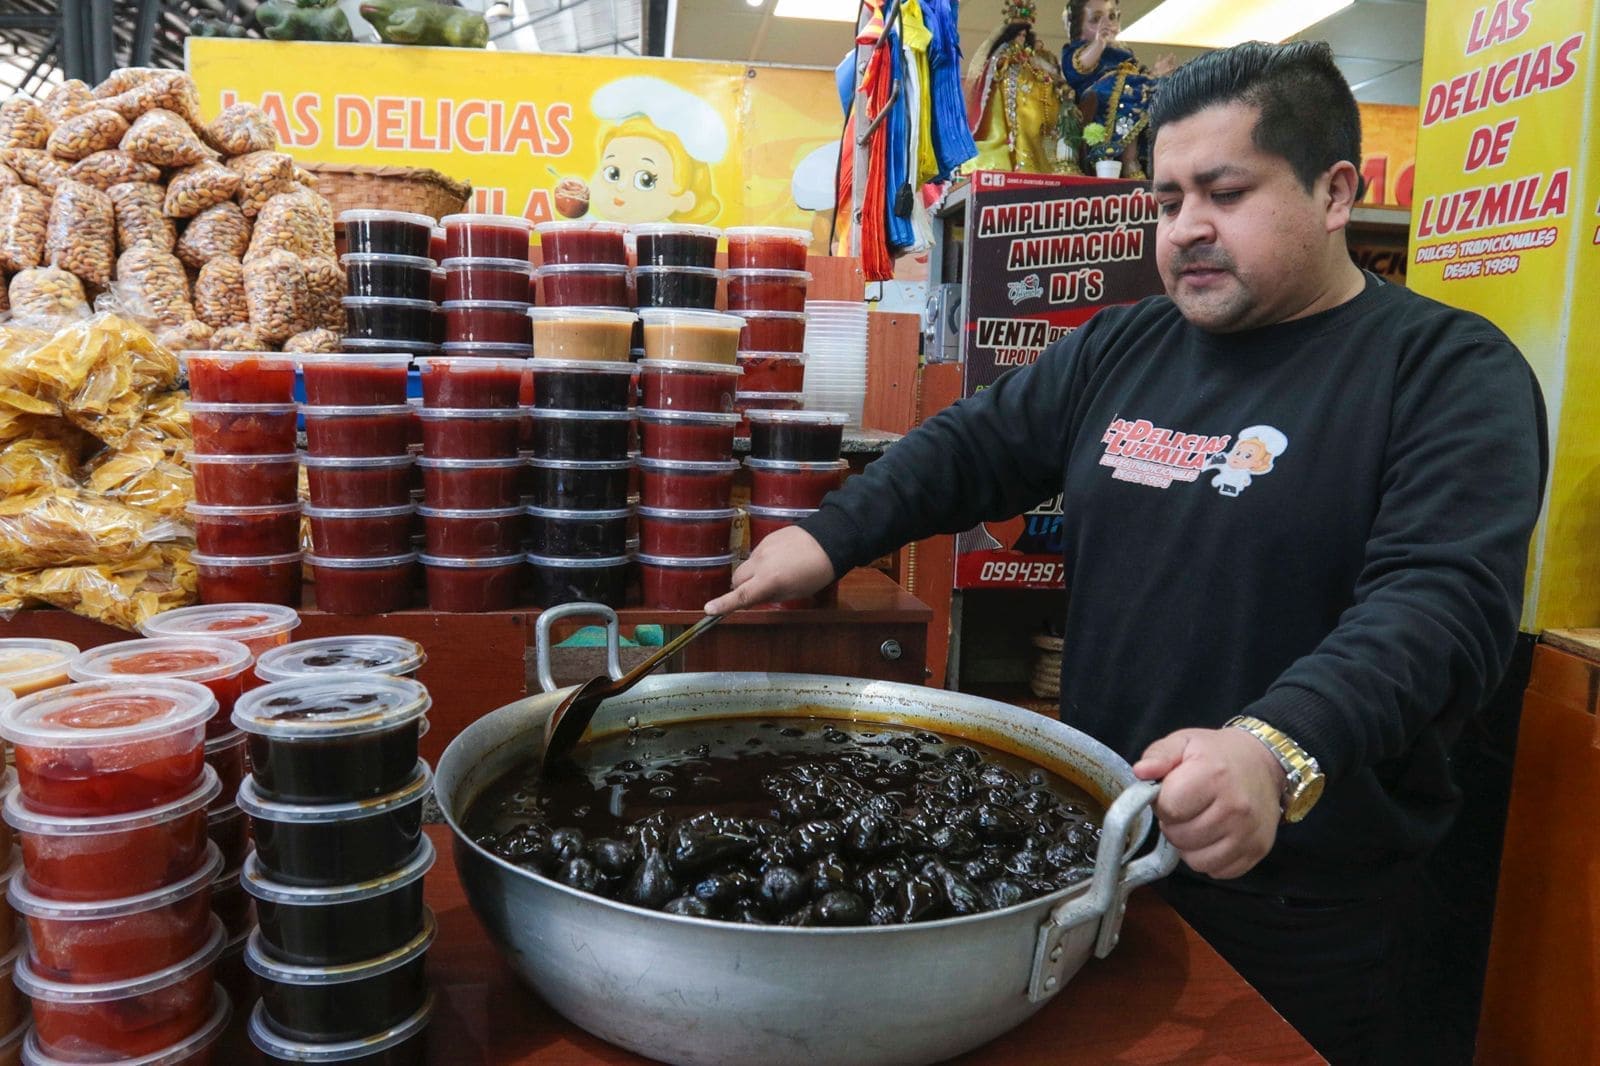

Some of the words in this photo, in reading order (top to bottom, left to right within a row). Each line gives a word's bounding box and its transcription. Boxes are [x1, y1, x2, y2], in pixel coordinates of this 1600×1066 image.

[1465, 0, 1534, 55] LAS
[1422, 33, 1583, 127] DELICIAS
[335, 94, 573, 157] DELICIAS
[1463, 116, 1520, 172] DE
[979, 188, 1158, 238] AMPLIFICACIÓN
[1416, 167, 1571, 241] LUZMILA
[1007, 225, 1144, 271] ANIMACIÓN
[1415, 242, 1458, 264] DULCES
[1459, 226, 1558, 258] TRADICIONALES
[1443, 260, 1483, 281] DESDE
[1484, 255, 1520, 277] 1984
[976, 317, 1049, 350] VENTA
[995, 347, 1026, 366] TIPO
[1105, 432, 1206, 470] LUZMILA
[1126, 419, 1232, 454] DELICIAS
[980, 561, 1065, 582] 0994397
